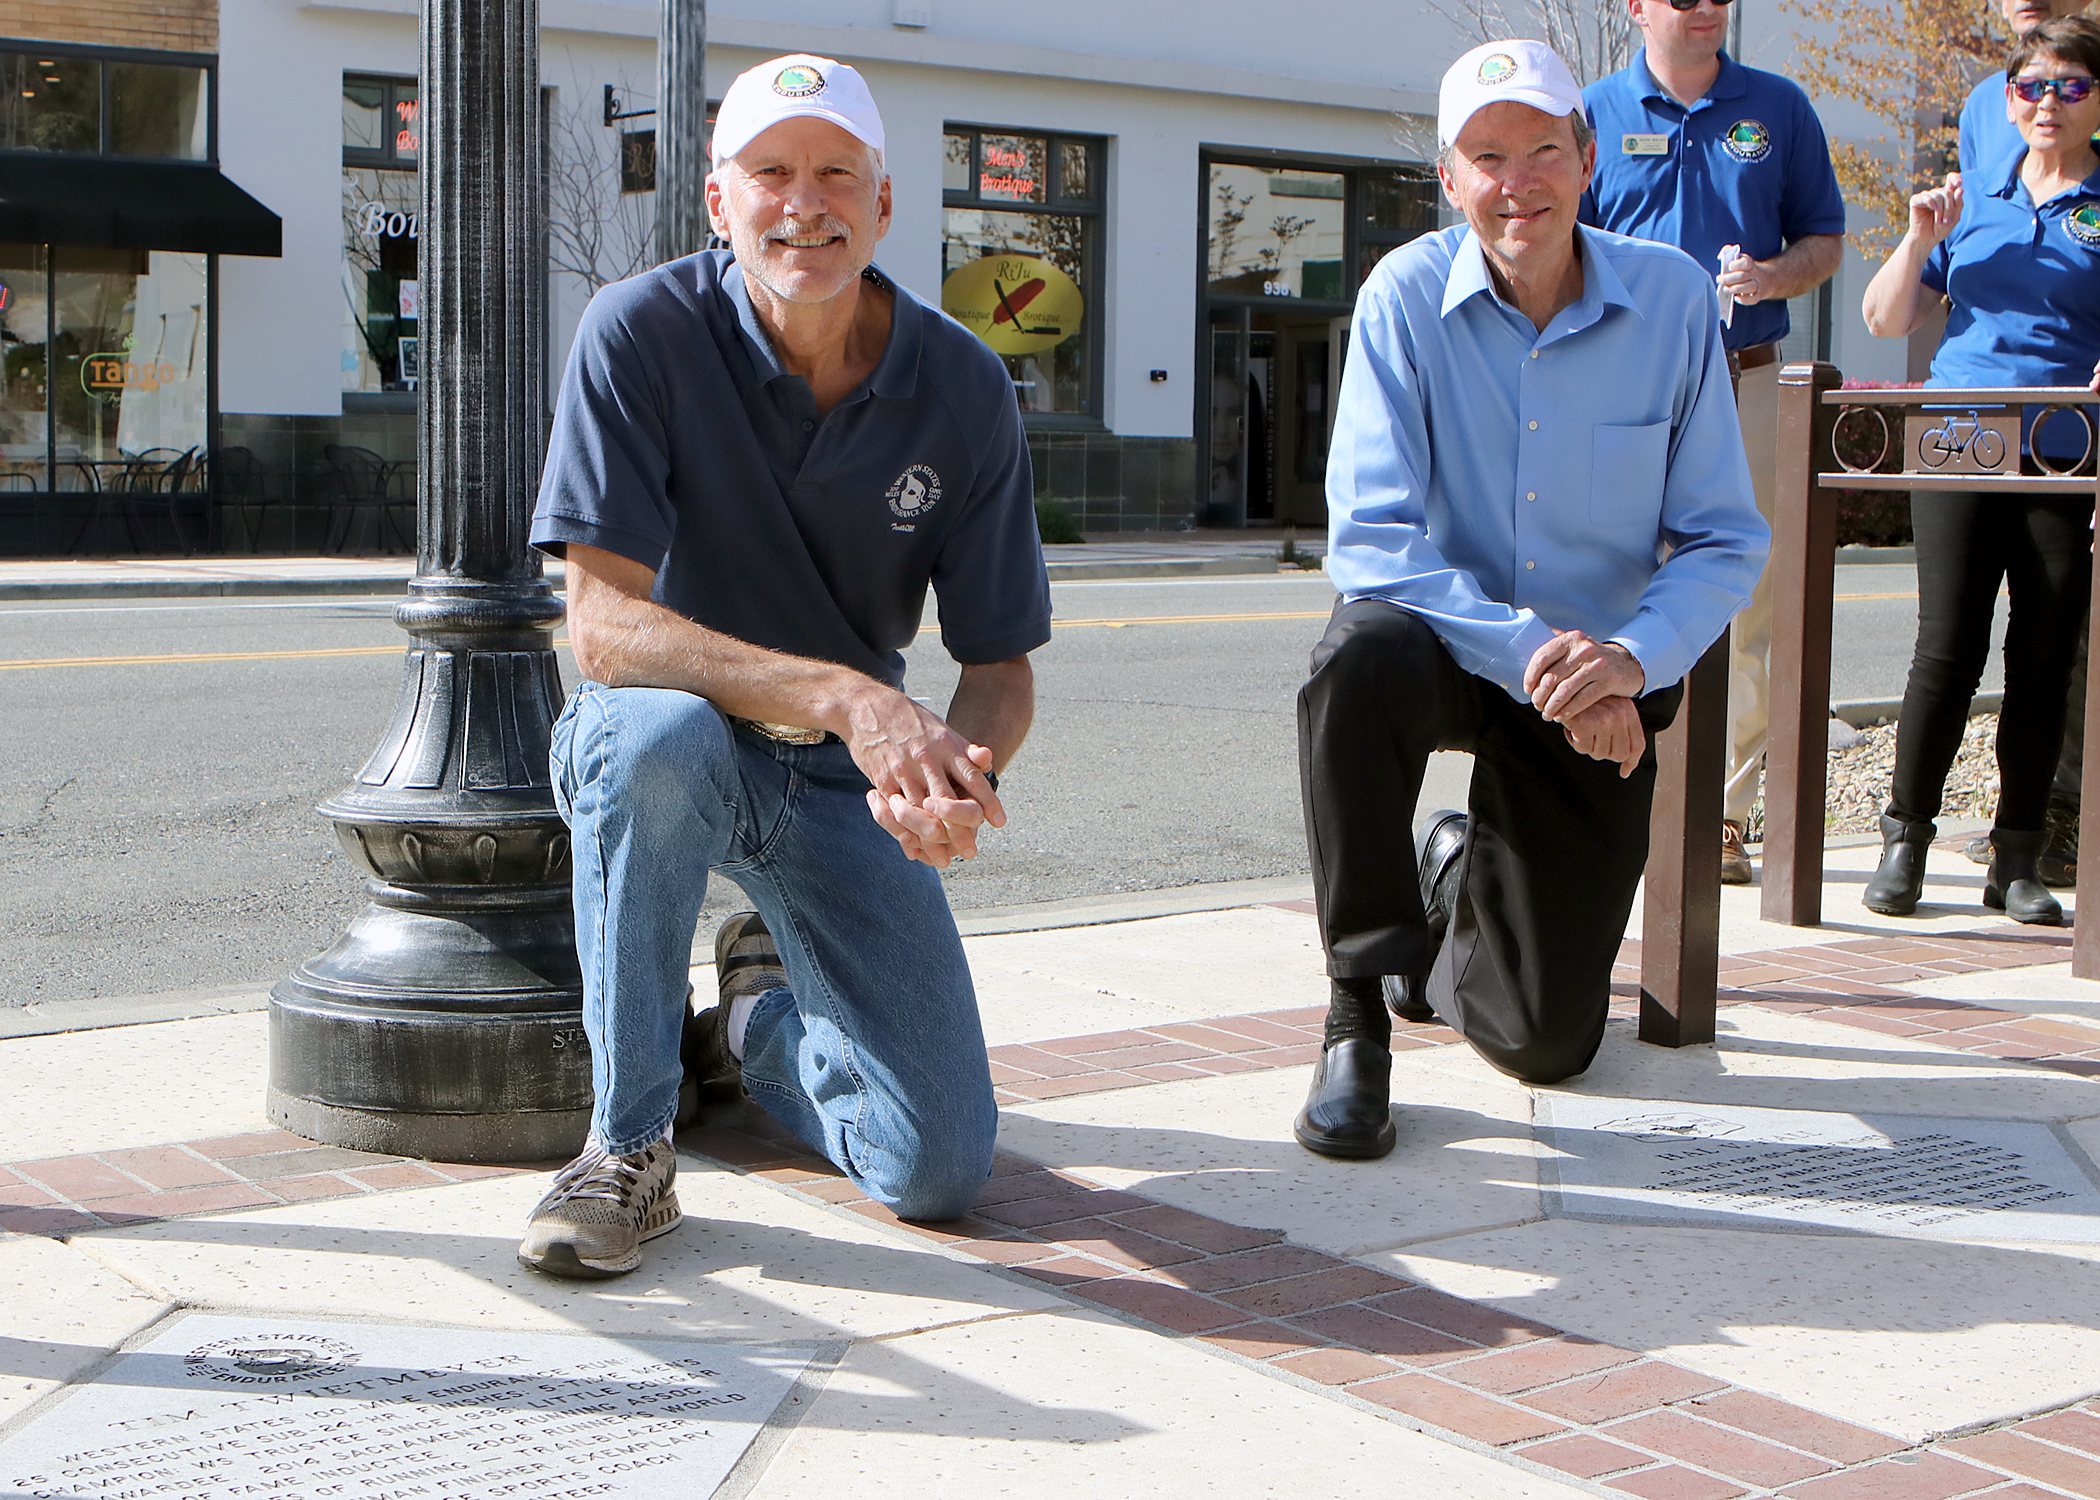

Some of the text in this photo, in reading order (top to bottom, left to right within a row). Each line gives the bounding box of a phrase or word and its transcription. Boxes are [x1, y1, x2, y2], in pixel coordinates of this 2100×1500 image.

[772, 79, 824, 97] ENDURANCE
[984, 148, 1026, 167] Men's
[1727, 137, 1769, 158] ENDURANCE
[980, 173, 1034, 199] Brotique
[1263, 281, 1290, 297] 938
[894, 464, 941, 488] WESTERN STATES
[888, 498, 936, 518] ENDURANCE RUN
[1655, 1148, 1719, 1161] HAL
[1800, 1165, 1911, 1184] INTERNATIONAL
[1907, 1154, 1954, 1165] TEVIS
[1994, 1164, 2027, 1172] FOR
[1927, 1188, 1963, 1197] THE
[1959, 1176, 2031, 1190] WESTERN
[1979, 1183, 2052, 1200] BETWEEN
[1982, 1200, 2029, 1211] LAKE
[257, 1333, 334, 1344] STATES
[320, 1341, 347, 1350] ONE
[328, 1345, 355, 1354] DAY
[186, 1367, 230, 1378] MILES
[187, 1363, 213, 1371] 100
[210, 1363, 348, 1384] ENDURANCE
[108, 1355, 533, 1431] TIM TWIETMEYER
[12, 1475, 49, 1487] 25
[62, 1440, 247, 1478] CONSECUTIVE
[256, 1412, 410, 1444] SUB-24-HR.
[539, 1372, 626, 1393] 5-TIME
[631, 1358, 701, 1375] MEN'S
[57, 1435, 190, 1463] WESTERN
[200, 1416, 296, 1440] STATES
[305, 1394, 422, 1421] 100-MILE
[427, 1368, 570, 1398] ENDURANCE
[191, 1457, 235, 1470] WS
[243, 1432, 368, 1460] TRUSTEE
[377, 1417, 449, 1437] SINCE
[527, 1387, 620, 1409] LITTLE
[627, 1369, 721, 1391] COUGAR
[258, 1457, 320, 1474] 2014
[331, 1423, 508, 1461] SACRAMENTO
[514, 1402, 618, 1427] RUNNING
[627, 1386, 709, 1406] ASSOC.
[228, 1476, 304, 1496] FAME
[312, 1450, 449, 1480] INDUCTEE.
[466, 1433, 534, 1450] 2006
[542, 1410, 654, 1437] RUNNER'S
[660, 1393, 748, 1414] WORLD
[315, 1484, 345, 1496] OF
[360, 1461, 471, 1487] RUNNING
[512, 1418, 700, 1457] TRAILBLAZER.
[436, 1462, 560, 1490] FINISHER.
[565, 1430, 714, 1464] EXEMPLARY
[488, 1453, 682, 1497] SPORTS COACH
